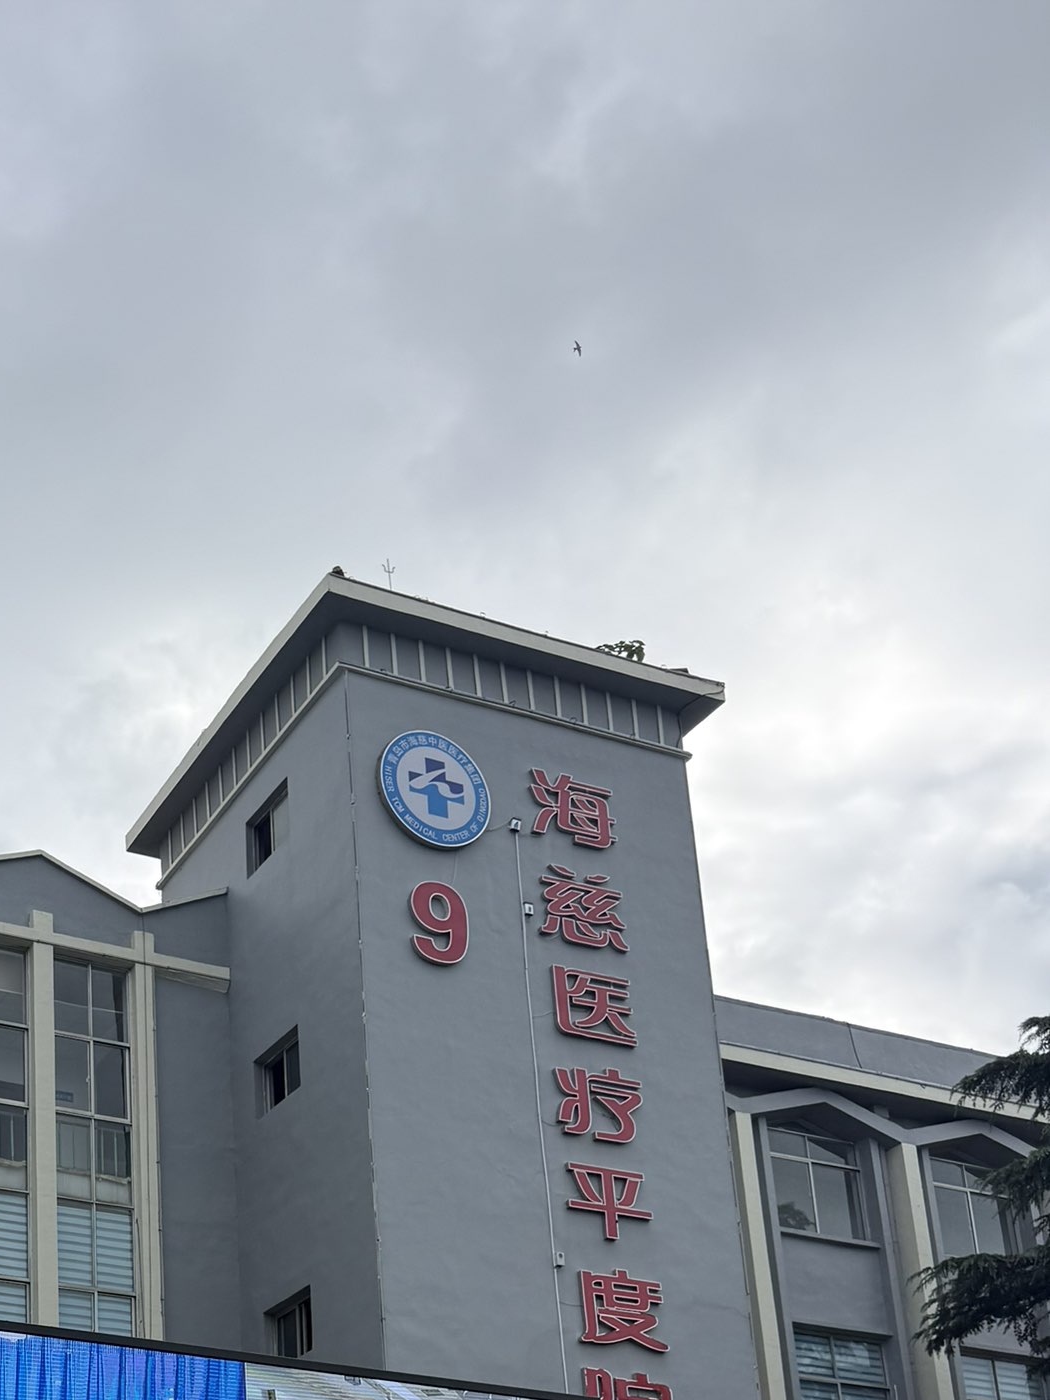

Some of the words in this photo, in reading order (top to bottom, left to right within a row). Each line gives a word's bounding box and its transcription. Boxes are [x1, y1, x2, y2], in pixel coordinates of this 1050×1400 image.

[403, 813, 438, 840] MEDICAL
[442, 829, 471, 842] CENTER
[410, 880, 471, 967] 9
